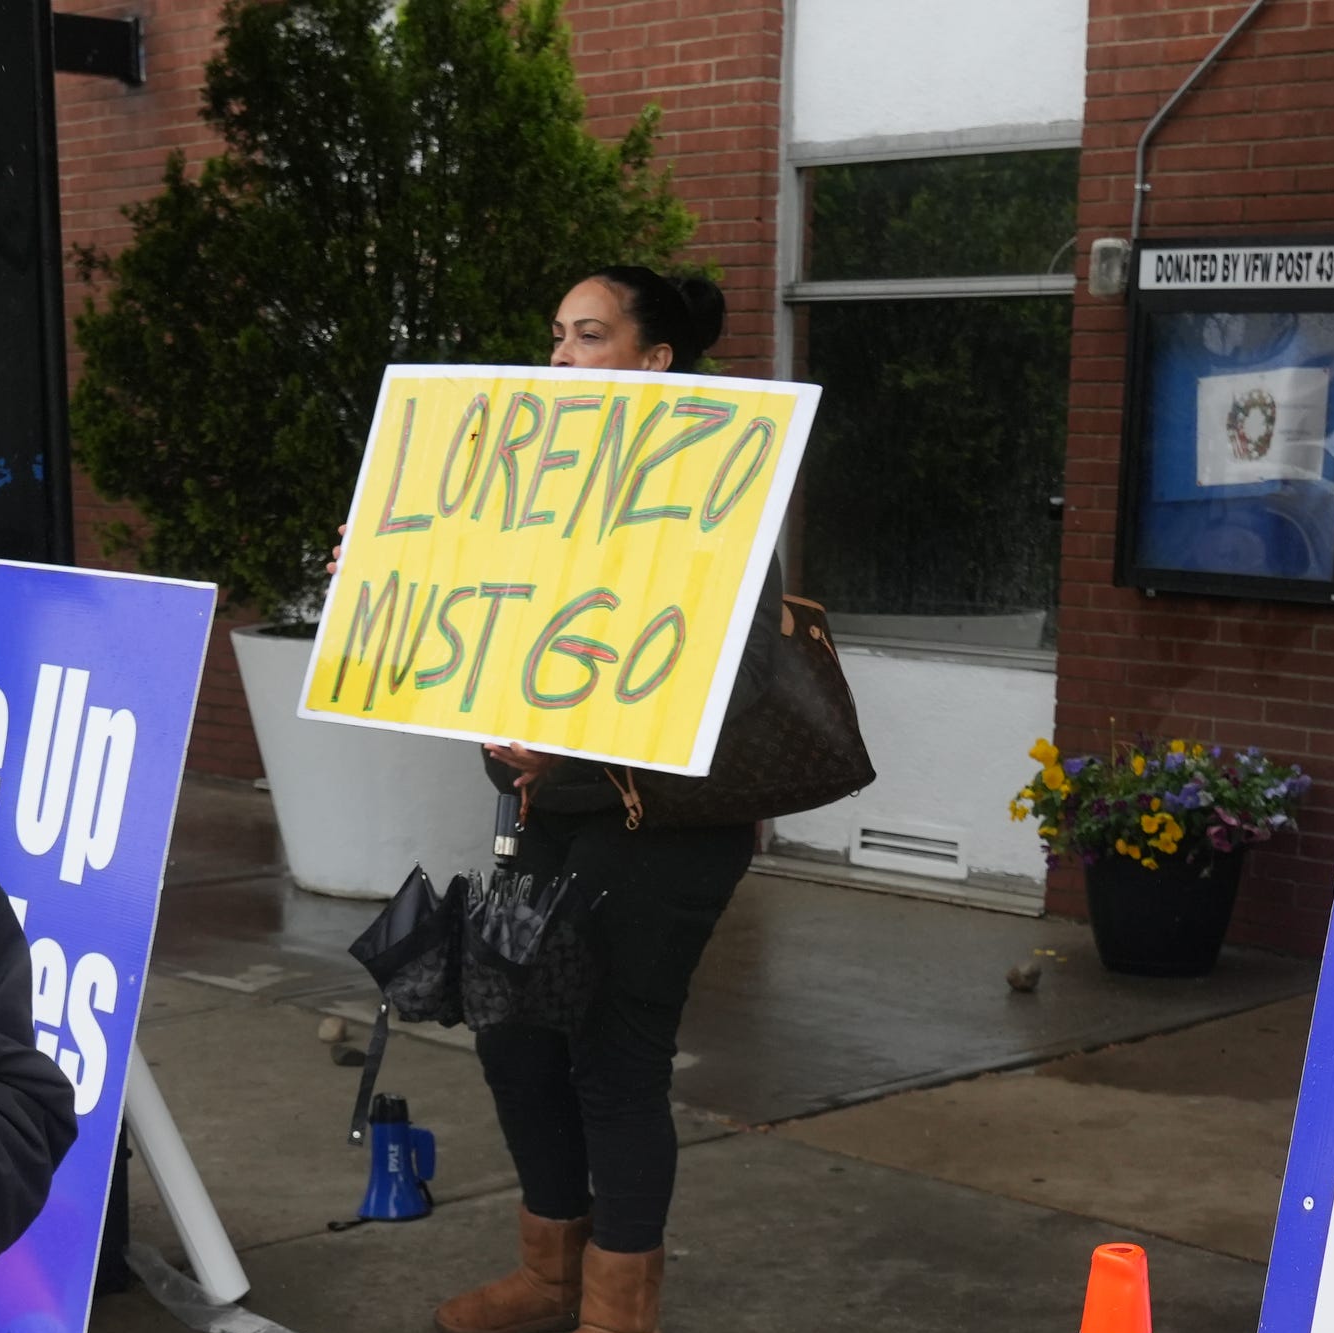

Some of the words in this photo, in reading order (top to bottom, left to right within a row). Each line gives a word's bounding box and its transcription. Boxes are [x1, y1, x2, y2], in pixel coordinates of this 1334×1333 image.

[1155, 254, 1217, 283] DONATED
[1221, 253, 1240, 283] BY
[1243, 253, 1272, 282] VFW
[1275, 252, 1312, 282] POST
[376, 392, 775, 544] LORENZO
[331, 570, 536, 713] MUST
[522, 587, 685, 709] GO
[16, 664, 137, 885] Up
